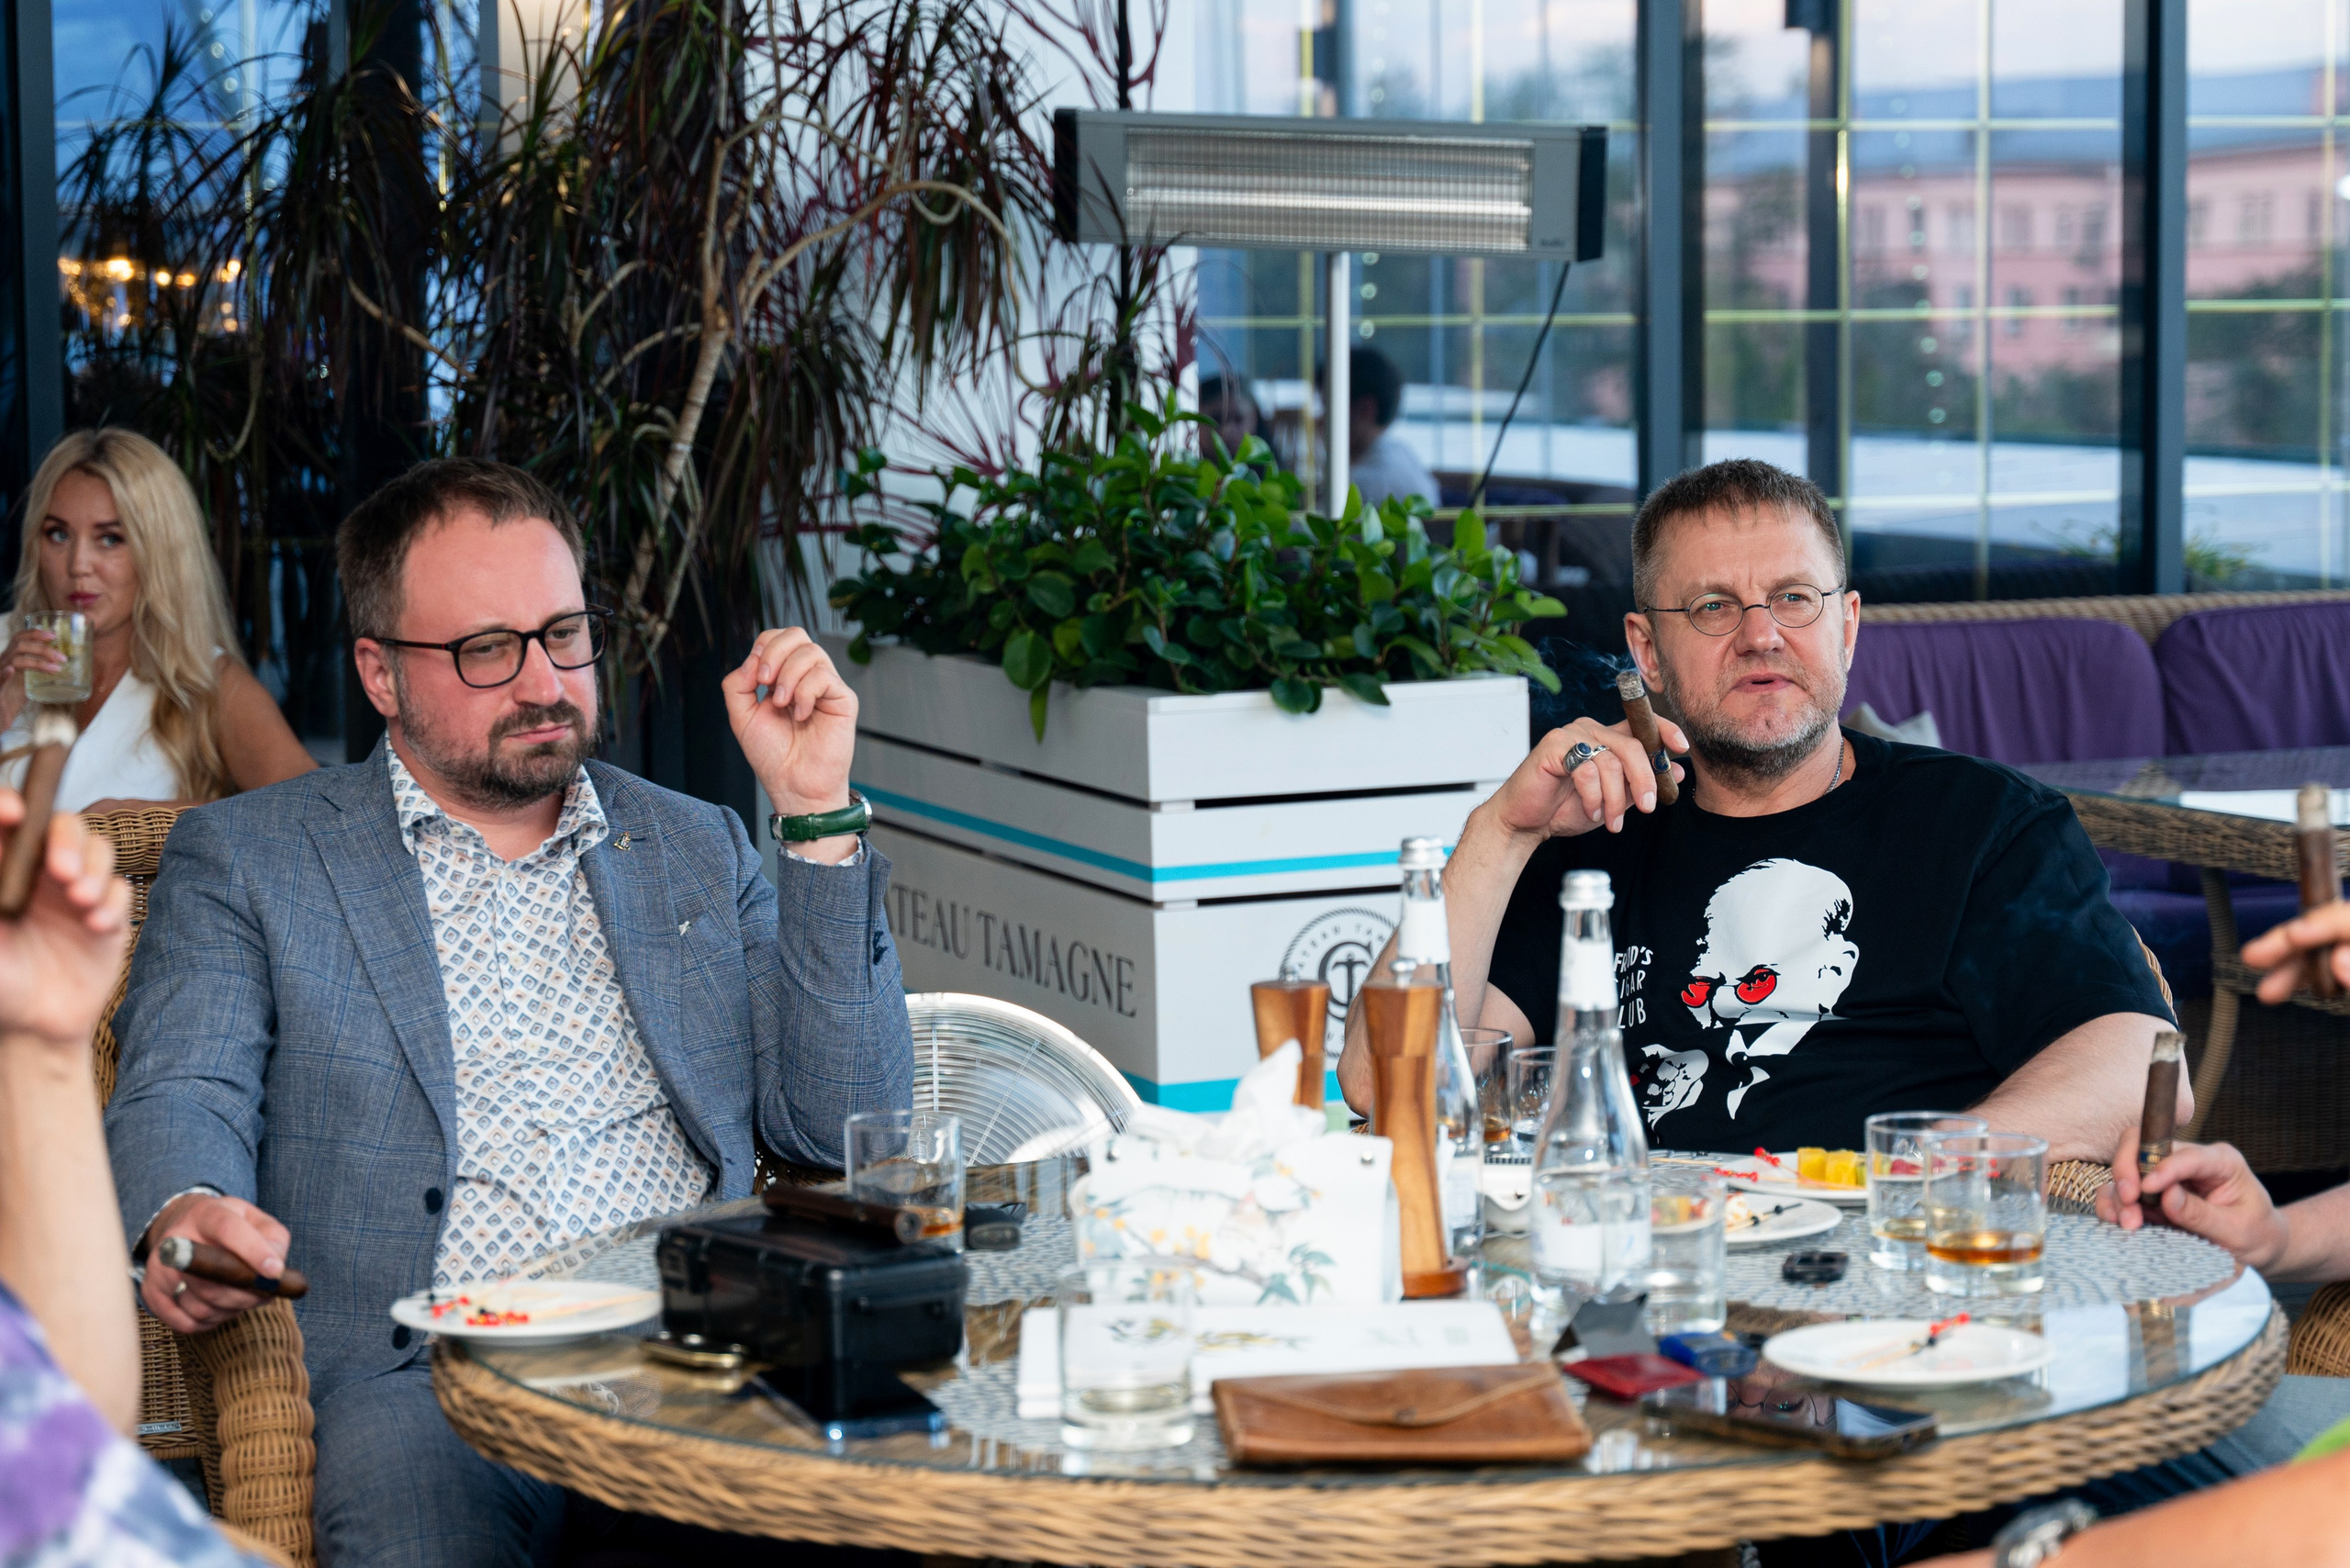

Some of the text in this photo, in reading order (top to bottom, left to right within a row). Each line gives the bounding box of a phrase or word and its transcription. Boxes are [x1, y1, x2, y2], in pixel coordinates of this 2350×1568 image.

[976, 910, 1137, 1018] TAMAGNE
[1614, 969, 1646, 999] IGAR
[1617, 998, 1647, 1029] LUB
